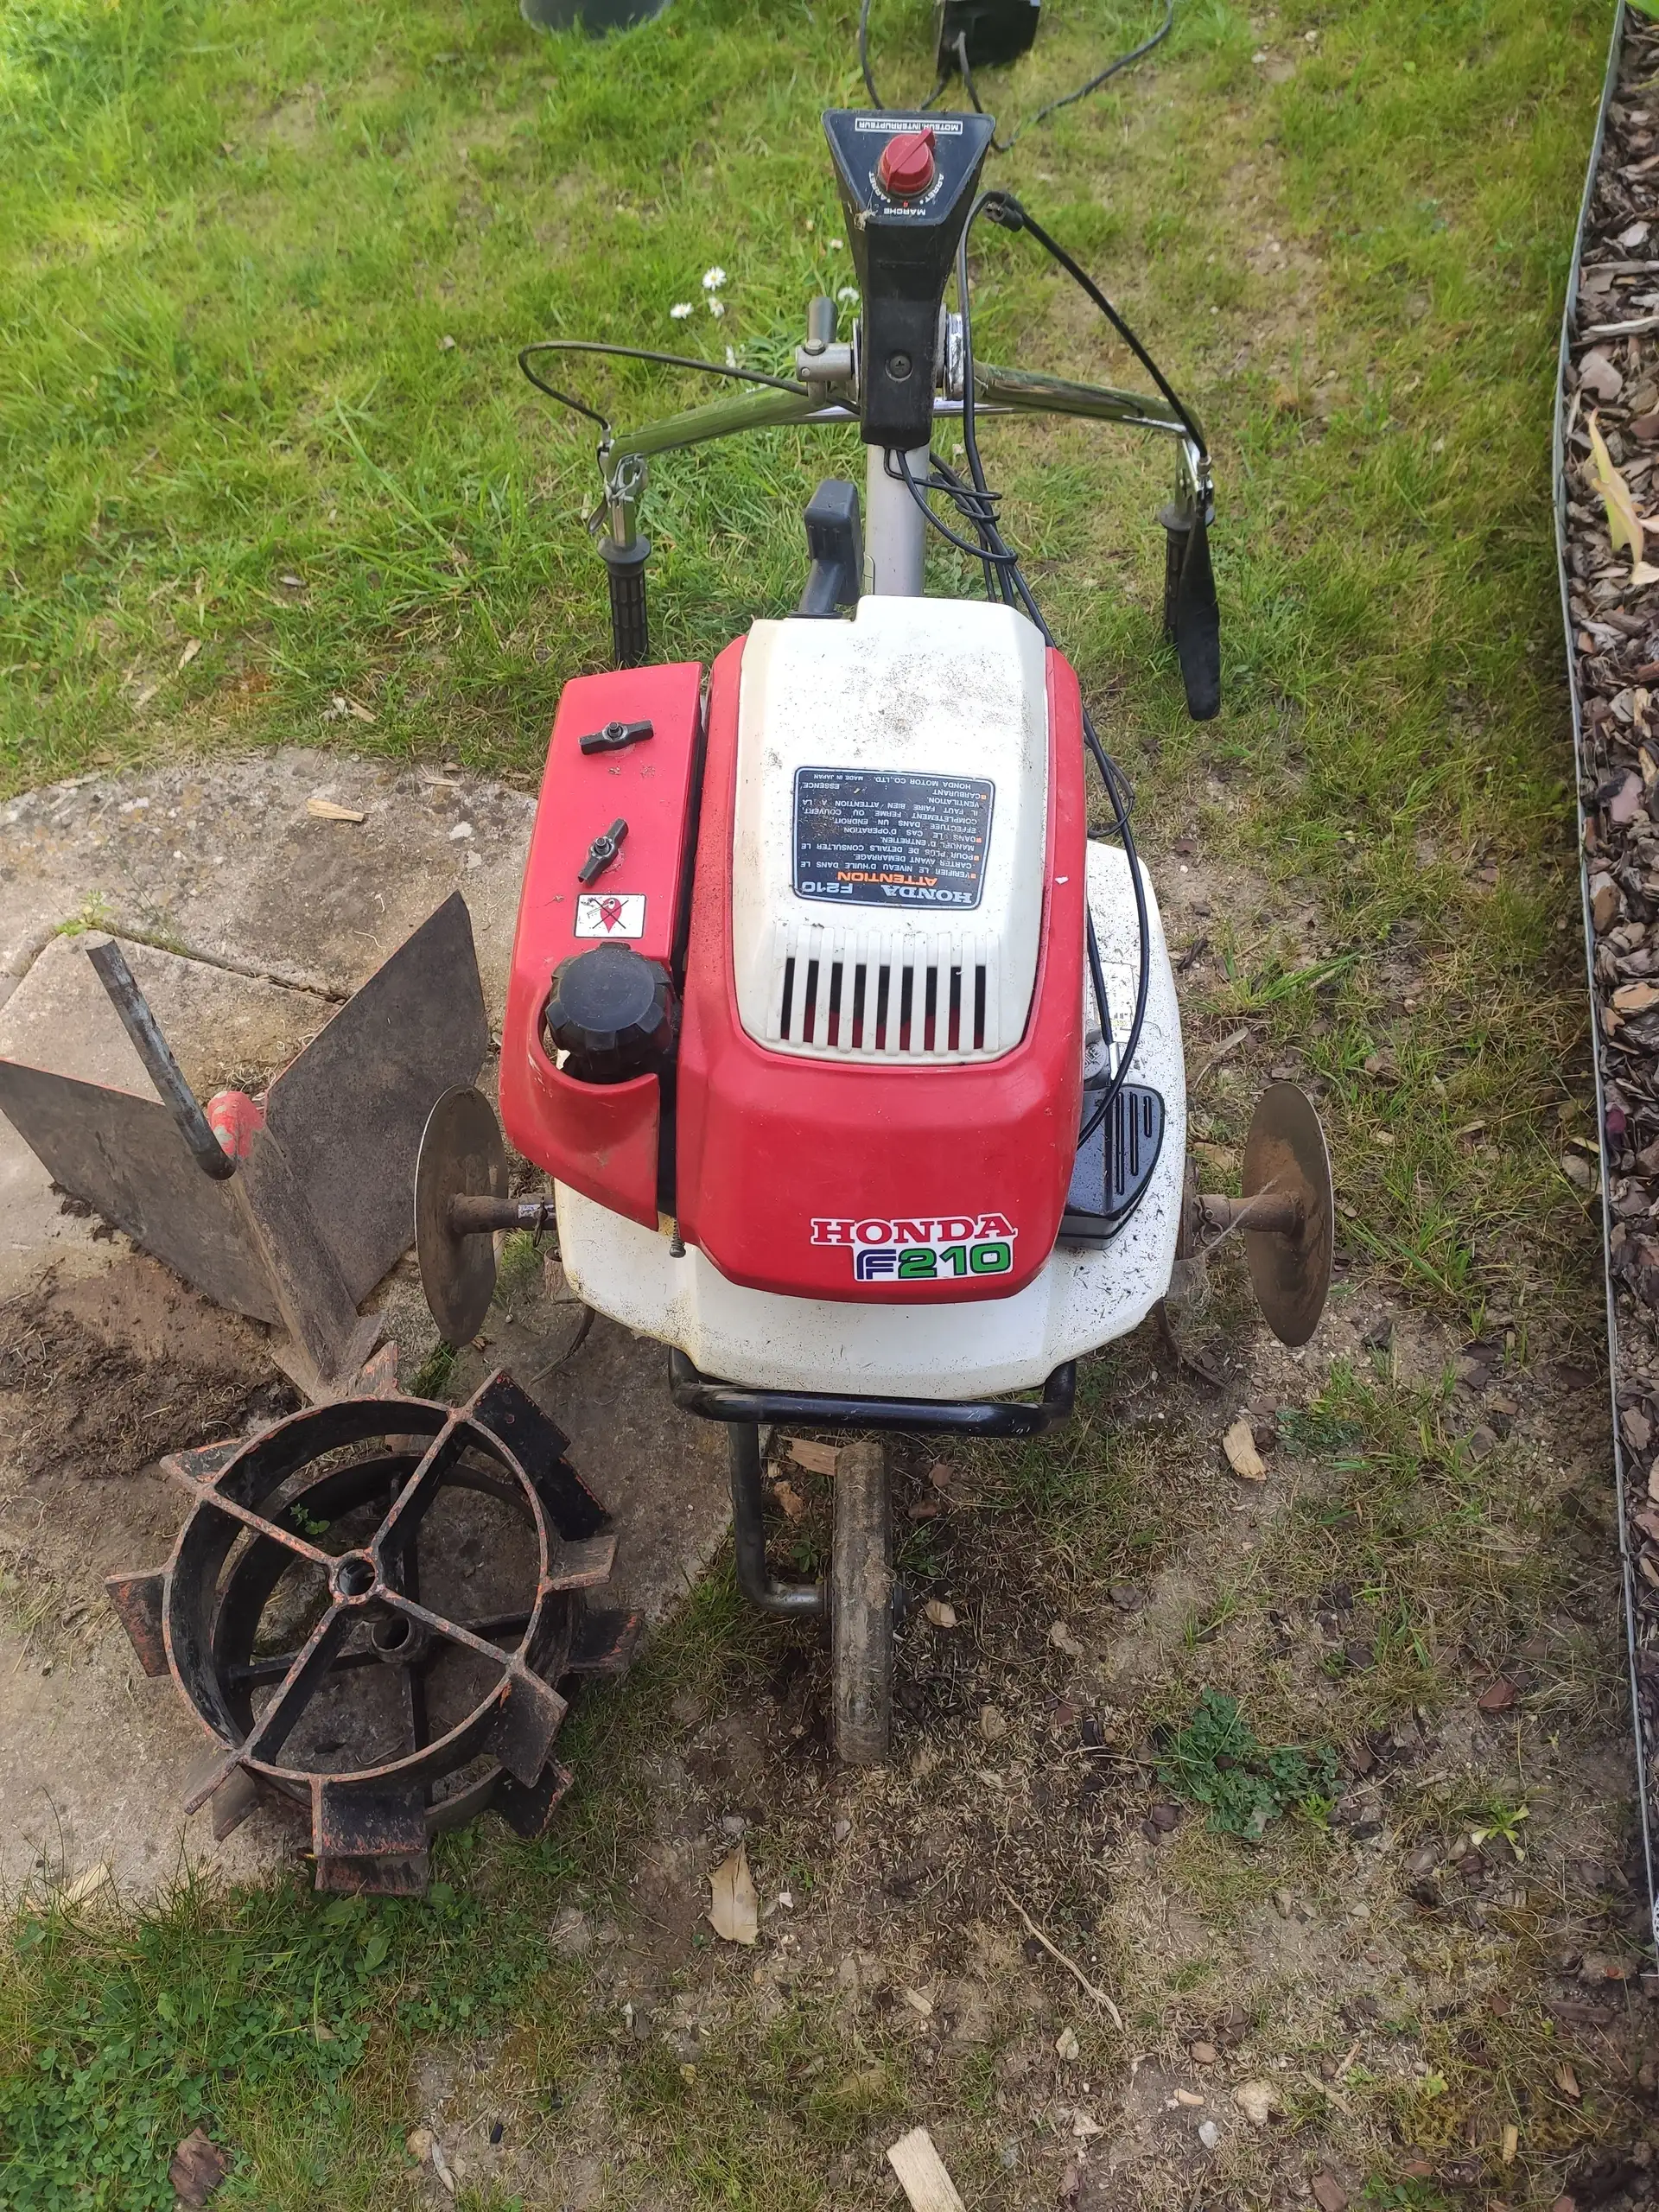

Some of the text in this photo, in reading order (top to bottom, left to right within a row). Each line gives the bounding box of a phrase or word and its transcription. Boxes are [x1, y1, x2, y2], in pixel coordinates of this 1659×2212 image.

[868, 171, 887, 200] ARRET
[924, 173, 944, 201] ARRET
[943, 781, 971, 790] HONDA
[932, 789, 981, 799] CARBURANT
[926, 797, 979, 808] VENTILATION.
[912, 812, 977, 825] COMPLETEMENT
[930, 823, 976, 833] EFFECTUEE
[953, 834, 976, 842] DANS
[940, 842, 975, 851] MANUEL
[853, 854, 972, 869] CARTER AVANT DEMARRAGE.
[837, 872, 938, 887] ATTENTION
[935, 868, 969, 879] VERIFIER
[802, 881, 972, 904] HONDA F210
[813, 1215, 1016, 1244] HONDA
[857, 1242, 1011, 1280] F210
